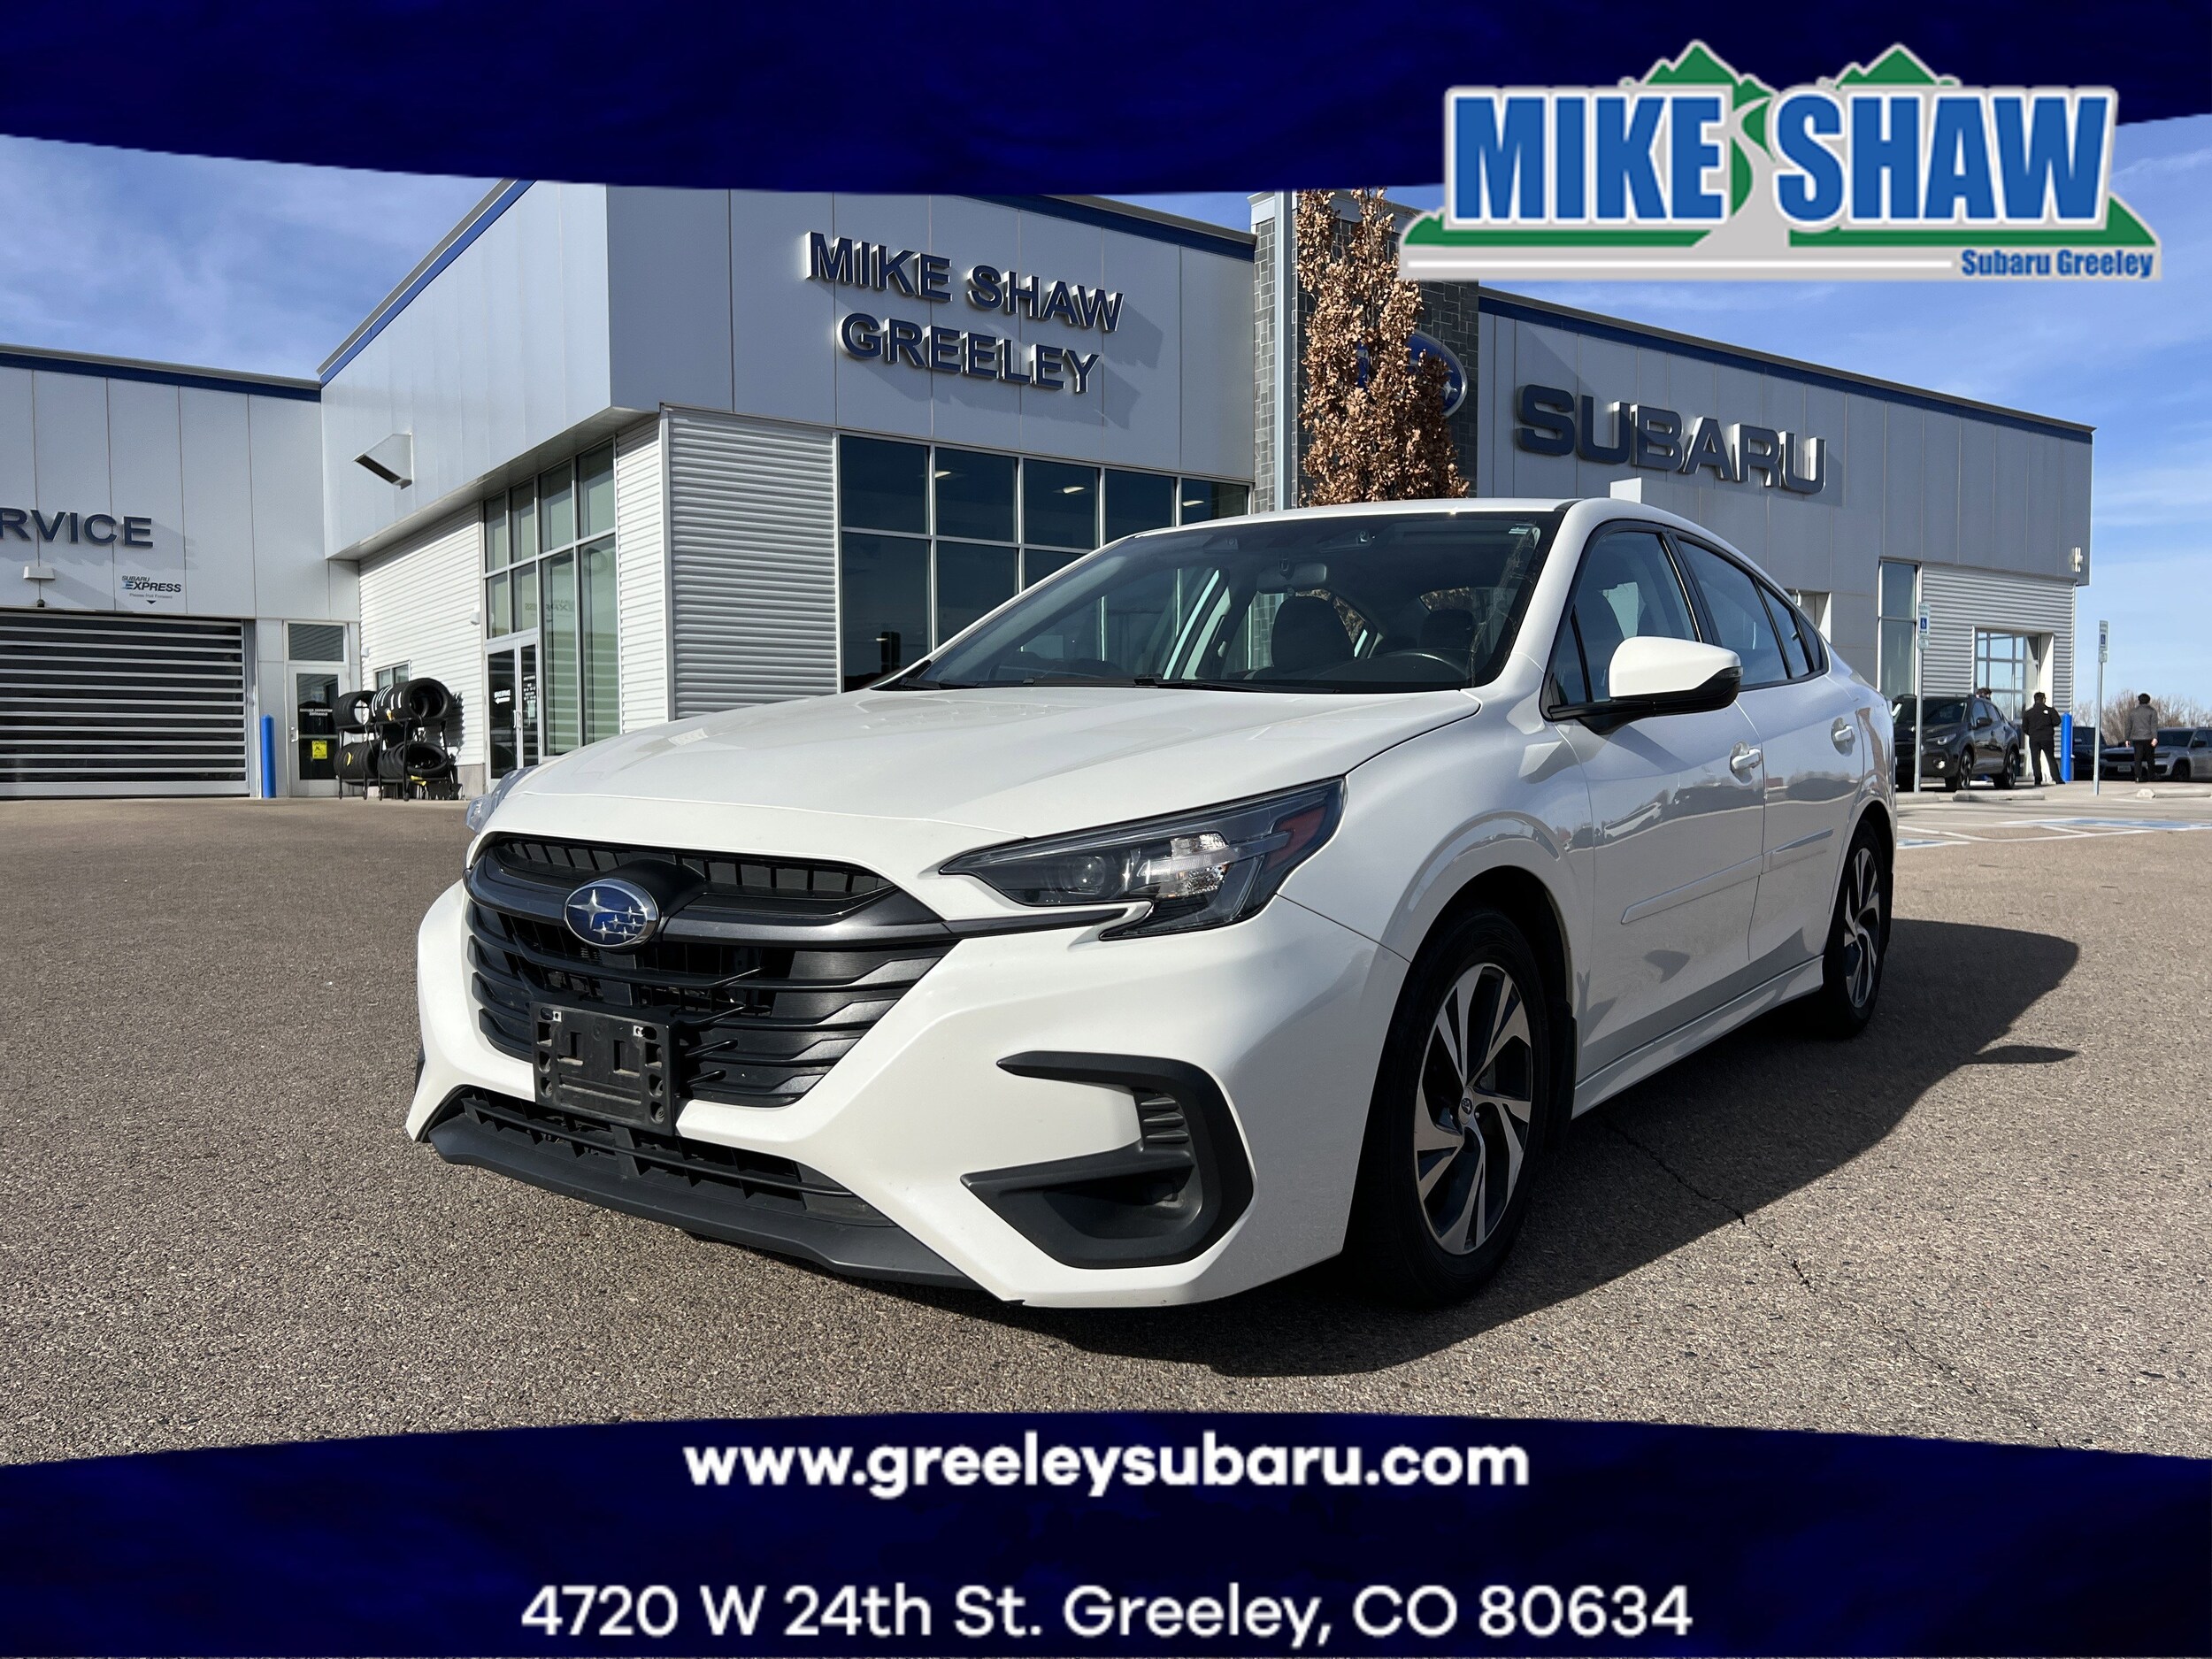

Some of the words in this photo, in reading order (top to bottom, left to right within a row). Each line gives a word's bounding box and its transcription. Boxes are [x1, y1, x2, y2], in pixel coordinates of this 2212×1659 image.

[806, 231, 953, 303] MIKE
[967, 265, 1125, 333] SHAW
[838, 312, 1100, 394] GREELEY
[1516, 383, 1827, 495] SUBARU
[0, 507, 154, 548] RVICE
[122, 580, 181, 592] EXPRESS
